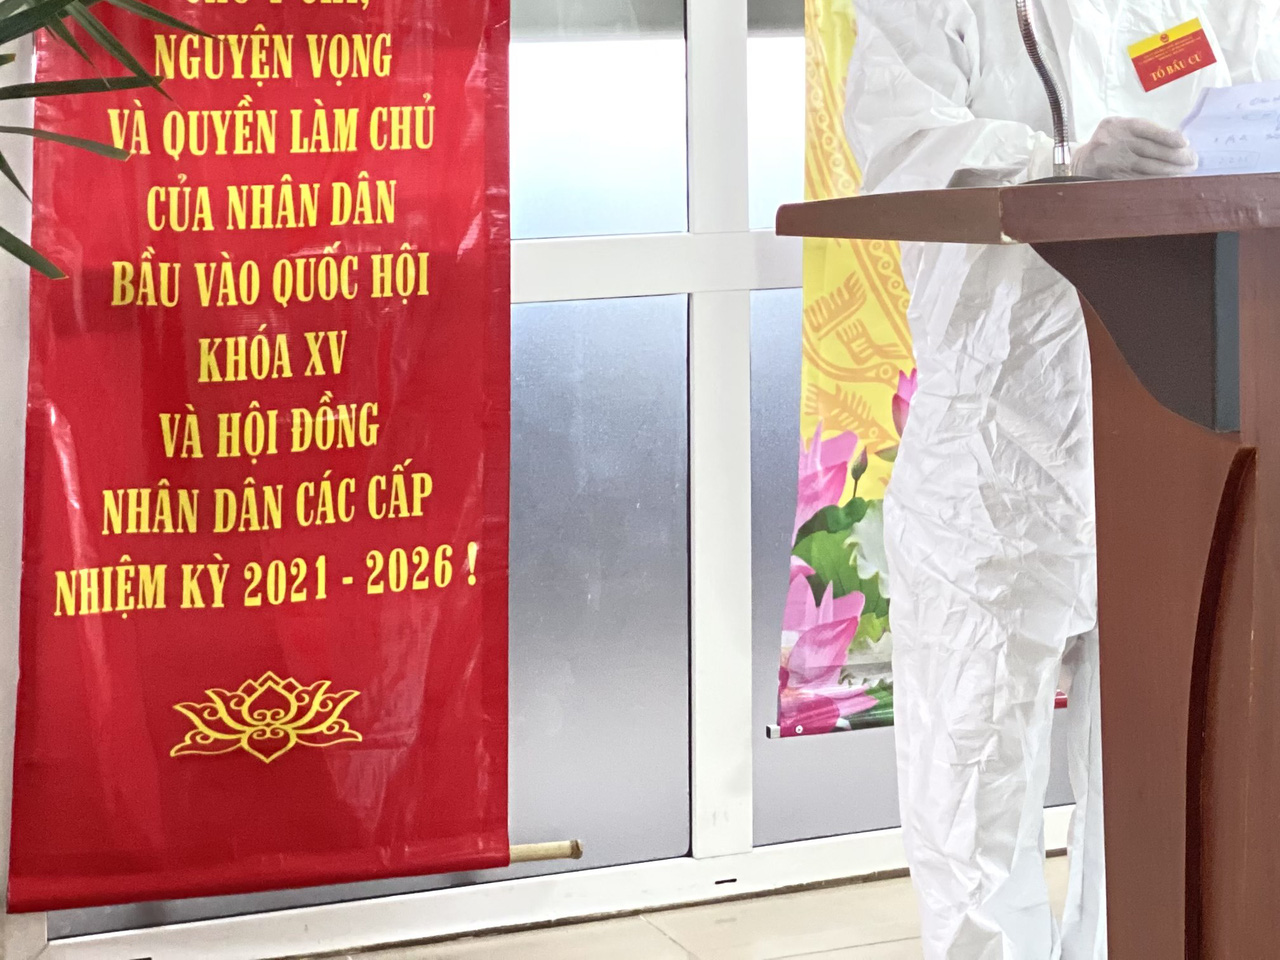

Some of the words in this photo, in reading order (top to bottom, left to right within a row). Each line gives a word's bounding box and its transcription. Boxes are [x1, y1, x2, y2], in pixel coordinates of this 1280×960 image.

[154, 23, 293, 87] NGUYỆN
[306, 33, 392, 86] VỌNG
[107, 99, 150, 155] VÀ
[162, 94, 278, 160] QUYỀN
[289, 98, 359, 154] LÀM
[369, 93, 435, 151] CHỦ
[146, 174, 214, 232] CỦA
[227, 173, 320, 230] NHÂN
[330, 170, 397, 226] DÂN
[111, 246, 181, 307] BẦU
[194, 251, 260, 307] VÀO
[272, 241, 359, 307] QUỐC
[370, 242, 429, 305] HỘI
[198, 324, 293, 383] KHÓA
[304, 330, 347, 376] XV
[159, 404, 204, 458] VÀ
[217, 400, 278, 464] HỘI
[291, 391, 379, 453] ĐỒNG
[101, 479, 199, 535] NHÂN
[213, 476, 283, 533] DÂN
[296, 469, 356, 527] CÁC
[367, 458, 433, 520] CẤP
[54, 554, 167, 619] NHIỆM
[180, 553, 229, 609] KỲ
[244, 555, 327, 607] 2021
[342, 576, 353, 585] -
[366, 544, 453, 595] 2026
[467, 541, 477, 586] !
